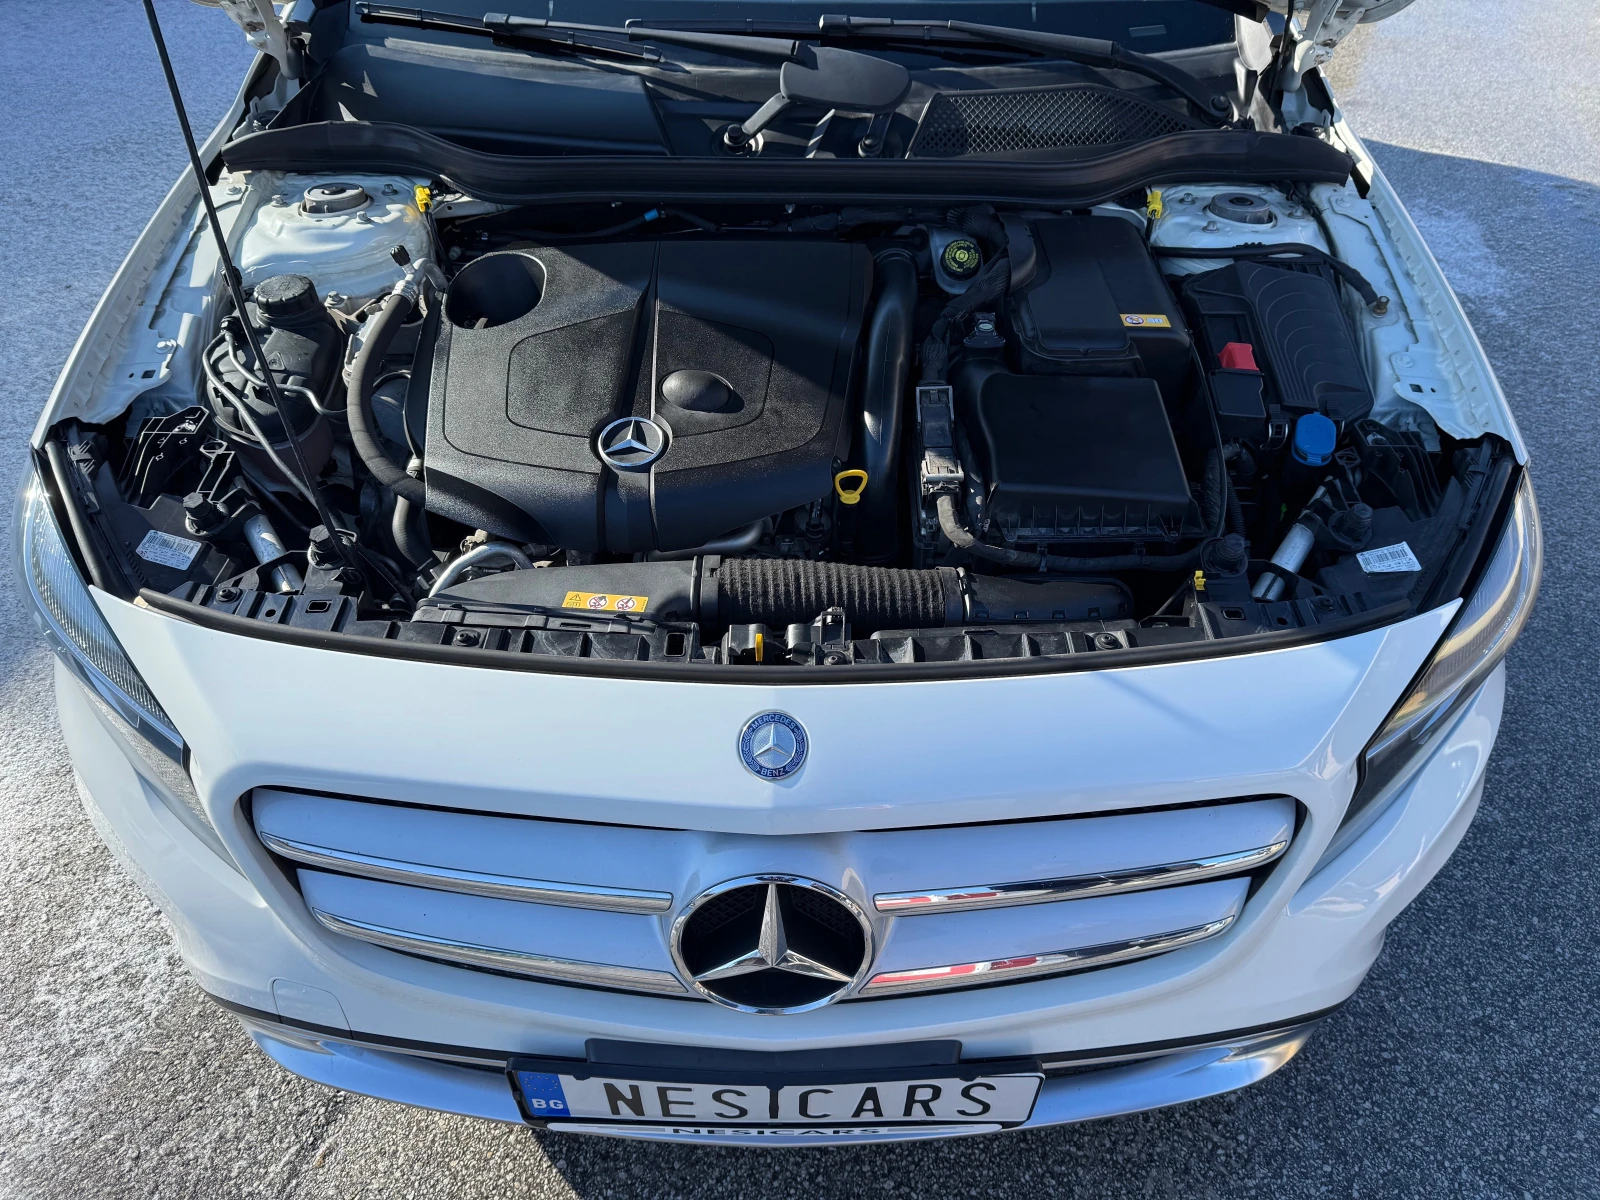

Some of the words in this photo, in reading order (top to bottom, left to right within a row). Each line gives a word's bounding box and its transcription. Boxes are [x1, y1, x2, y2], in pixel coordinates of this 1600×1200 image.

[751, 714, 796, 730] MERCEDES
[760, 768, 785, 777] BENZ
[531, 1098, 564, 1110] BG
[602, 1082, 997, 1119] NESICARS
[672, 1128, 880, 1136] NESICARS
